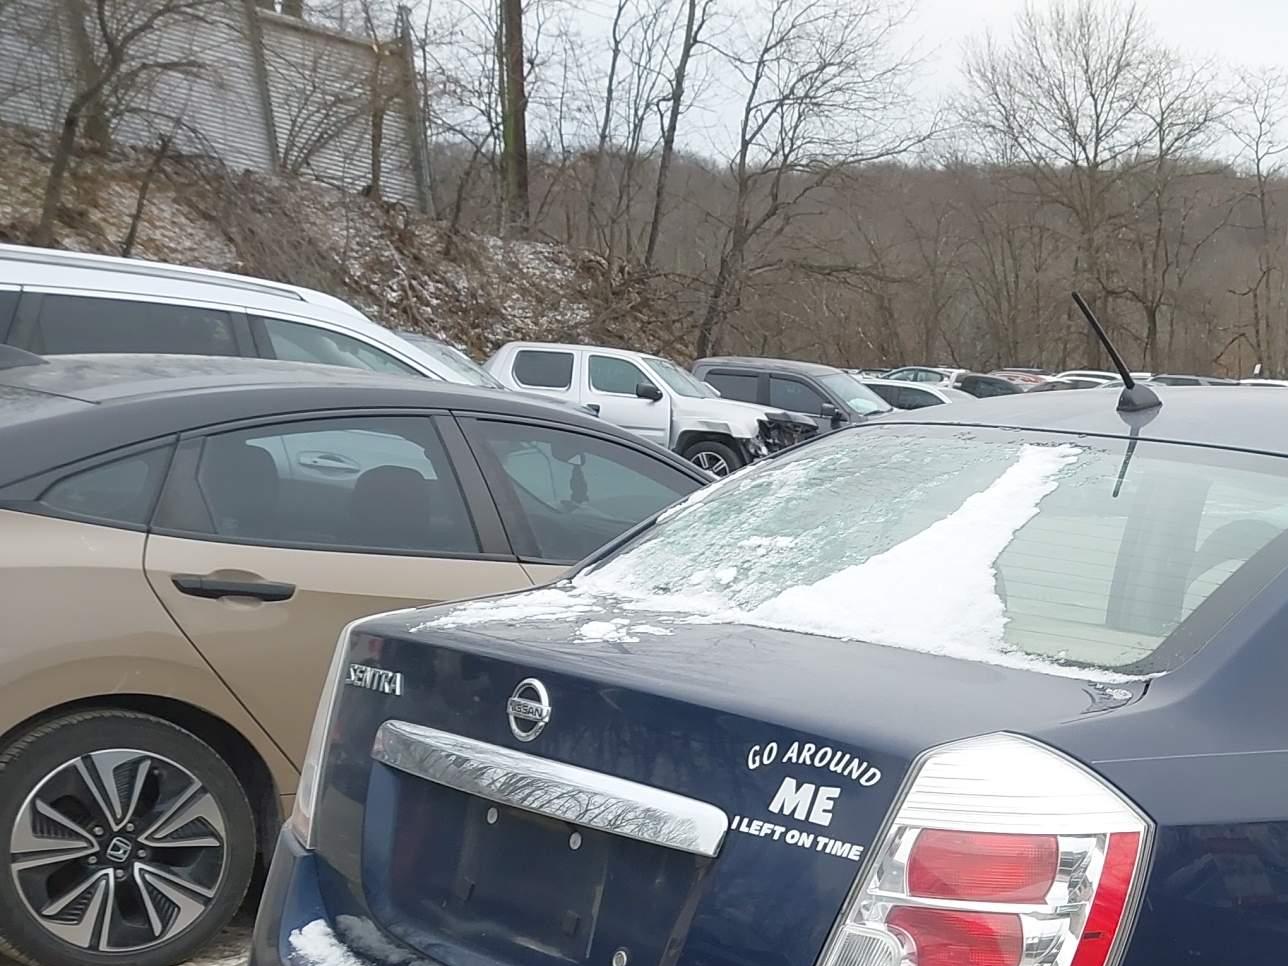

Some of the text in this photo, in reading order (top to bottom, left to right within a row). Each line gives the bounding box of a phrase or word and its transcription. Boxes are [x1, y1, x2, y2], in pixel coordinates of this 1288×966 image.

[345, 663, 402, 696] SENTRA
[509, 700, 544, 719] NISSAN
[747, 741, 882, 787] GO AROUND
[768, 776, 841, 827] ME
[730, 815, 865, 861] I LEFT ON TIME
